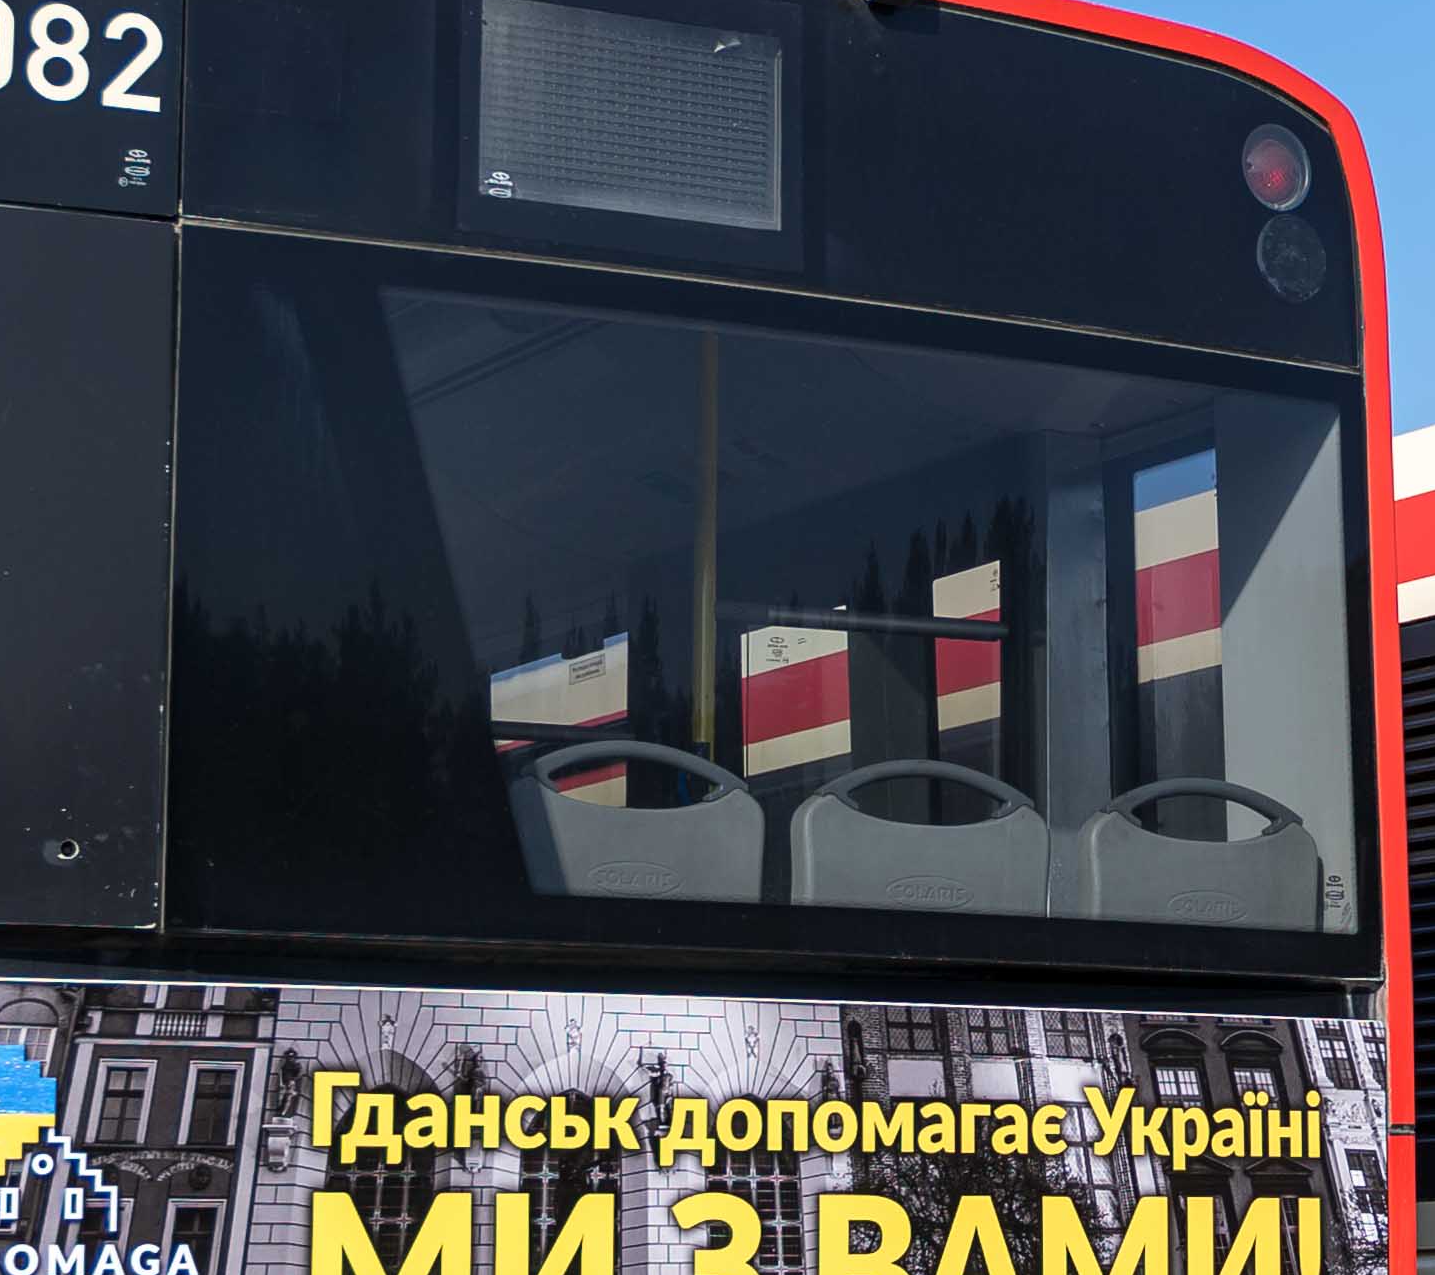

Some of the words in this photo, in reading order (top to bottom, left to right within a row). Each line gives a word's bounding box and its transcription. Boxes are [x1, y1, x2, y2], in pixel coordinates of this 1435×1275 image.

[312, 1071, 640, 1165] Гданськ
[659, 1098, 1067, 1167] допомагає
[1084, 1087, 1321, 1171] Україні
